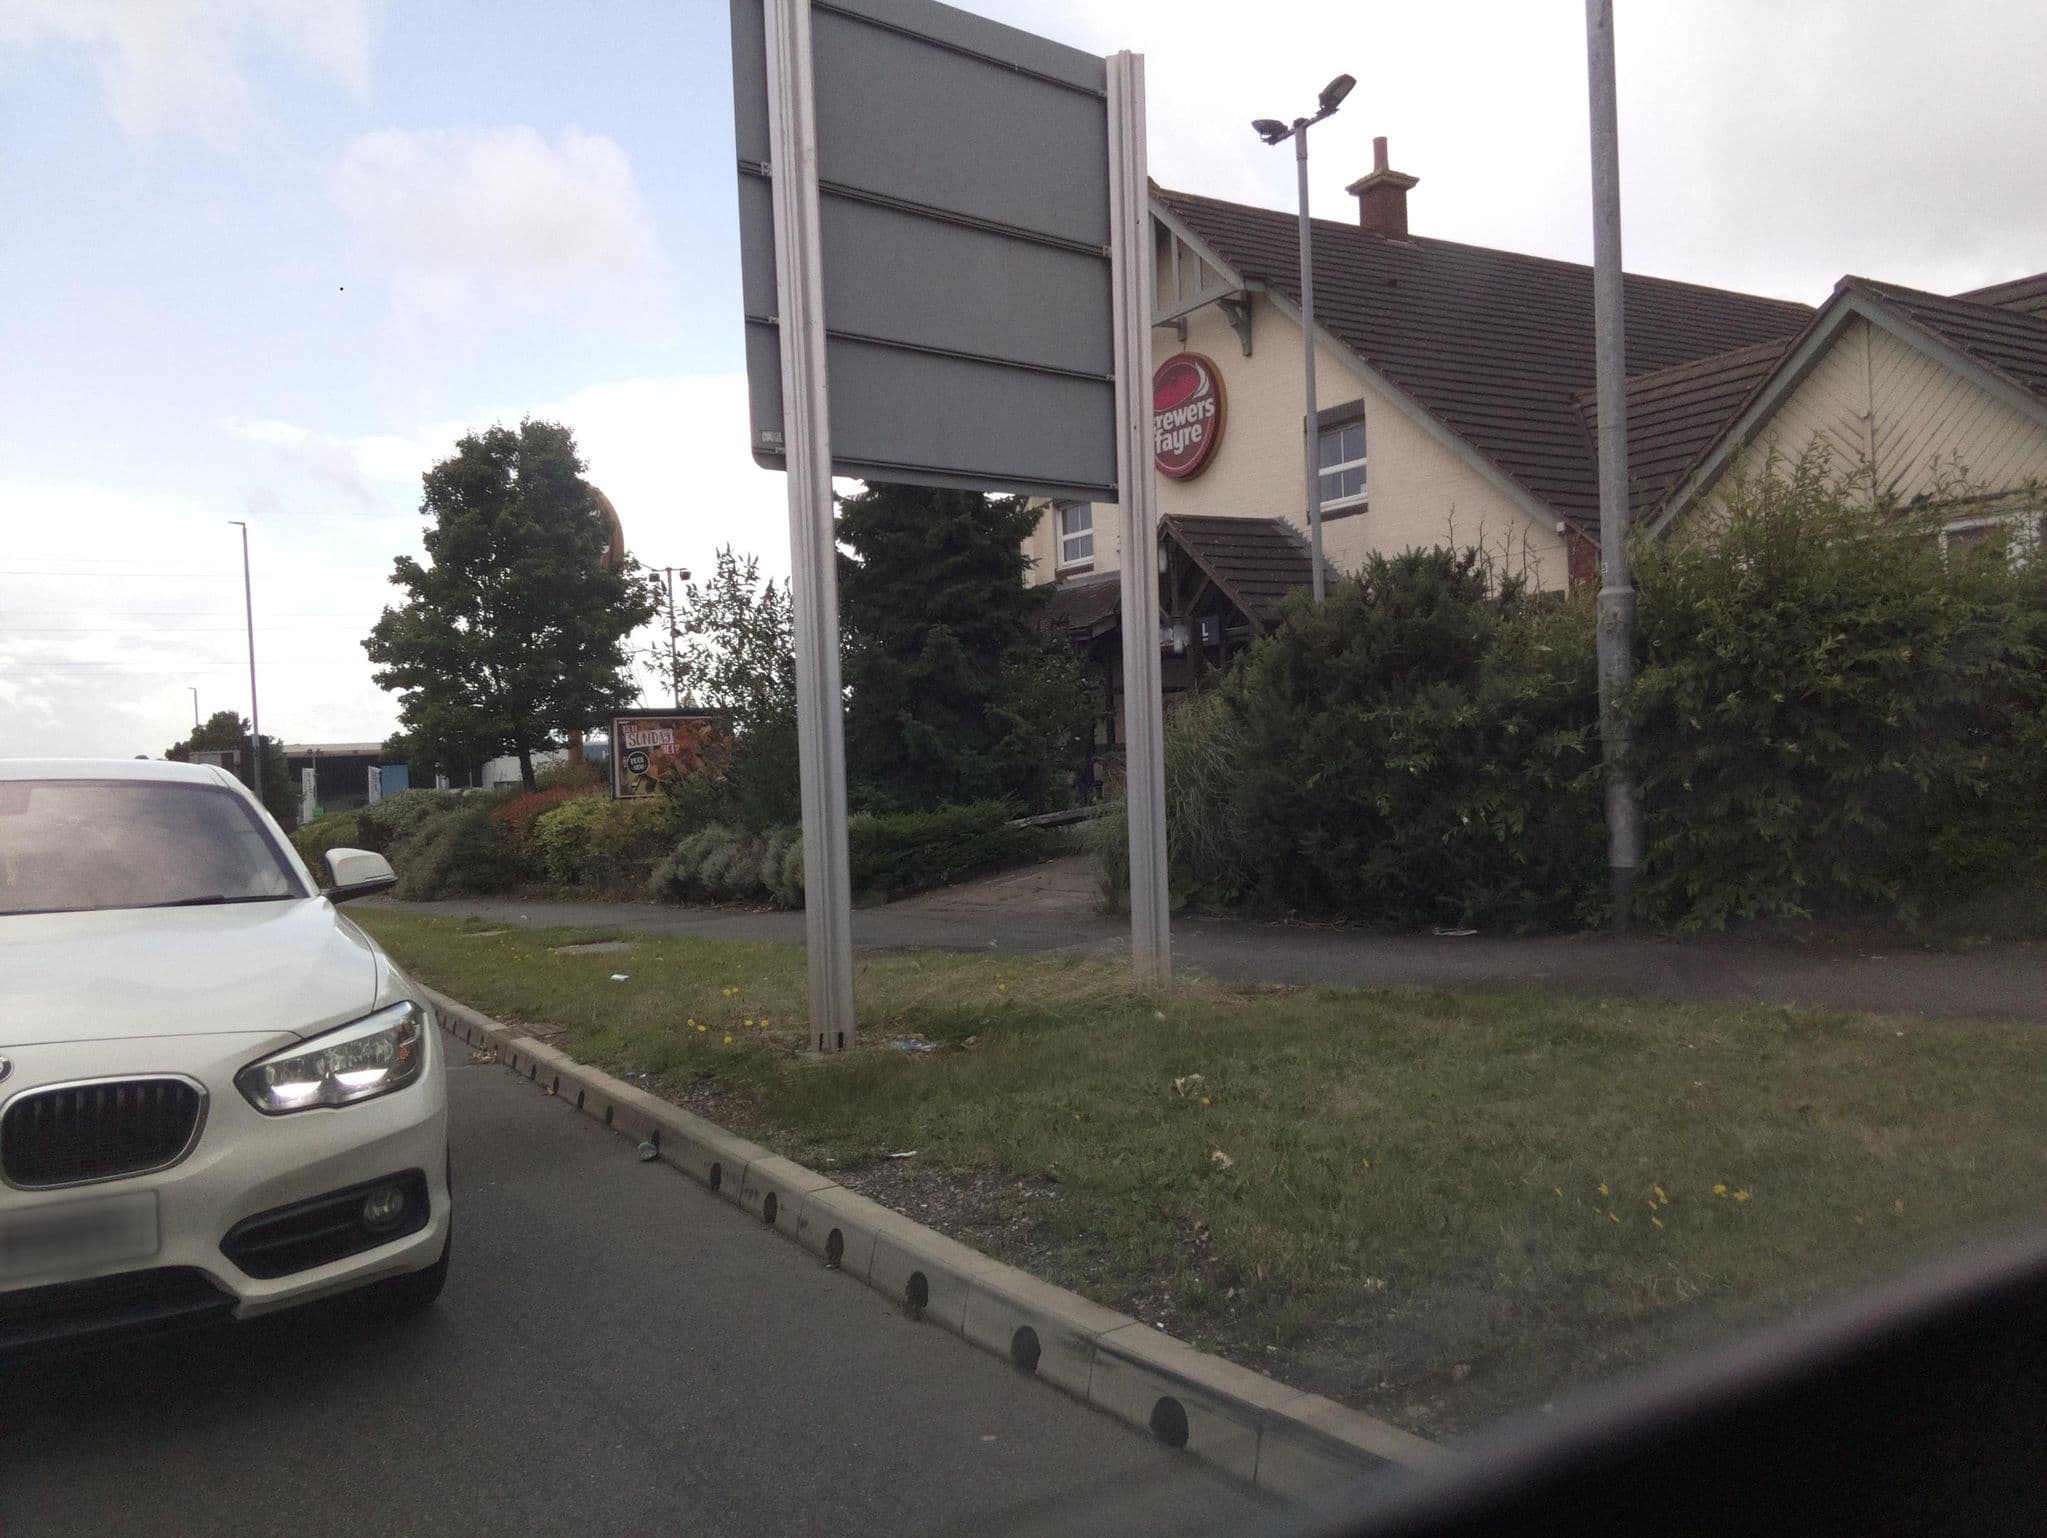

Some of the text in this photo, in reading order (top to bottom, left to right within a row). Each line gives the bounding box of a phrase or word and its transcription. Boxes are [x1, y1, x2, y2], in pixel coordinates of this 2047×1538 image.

[1153, 398, 1215, 431] rewers
[1154, 424, 1202, 455] fayre
[628, 731, 671, 746] SUNDAY
